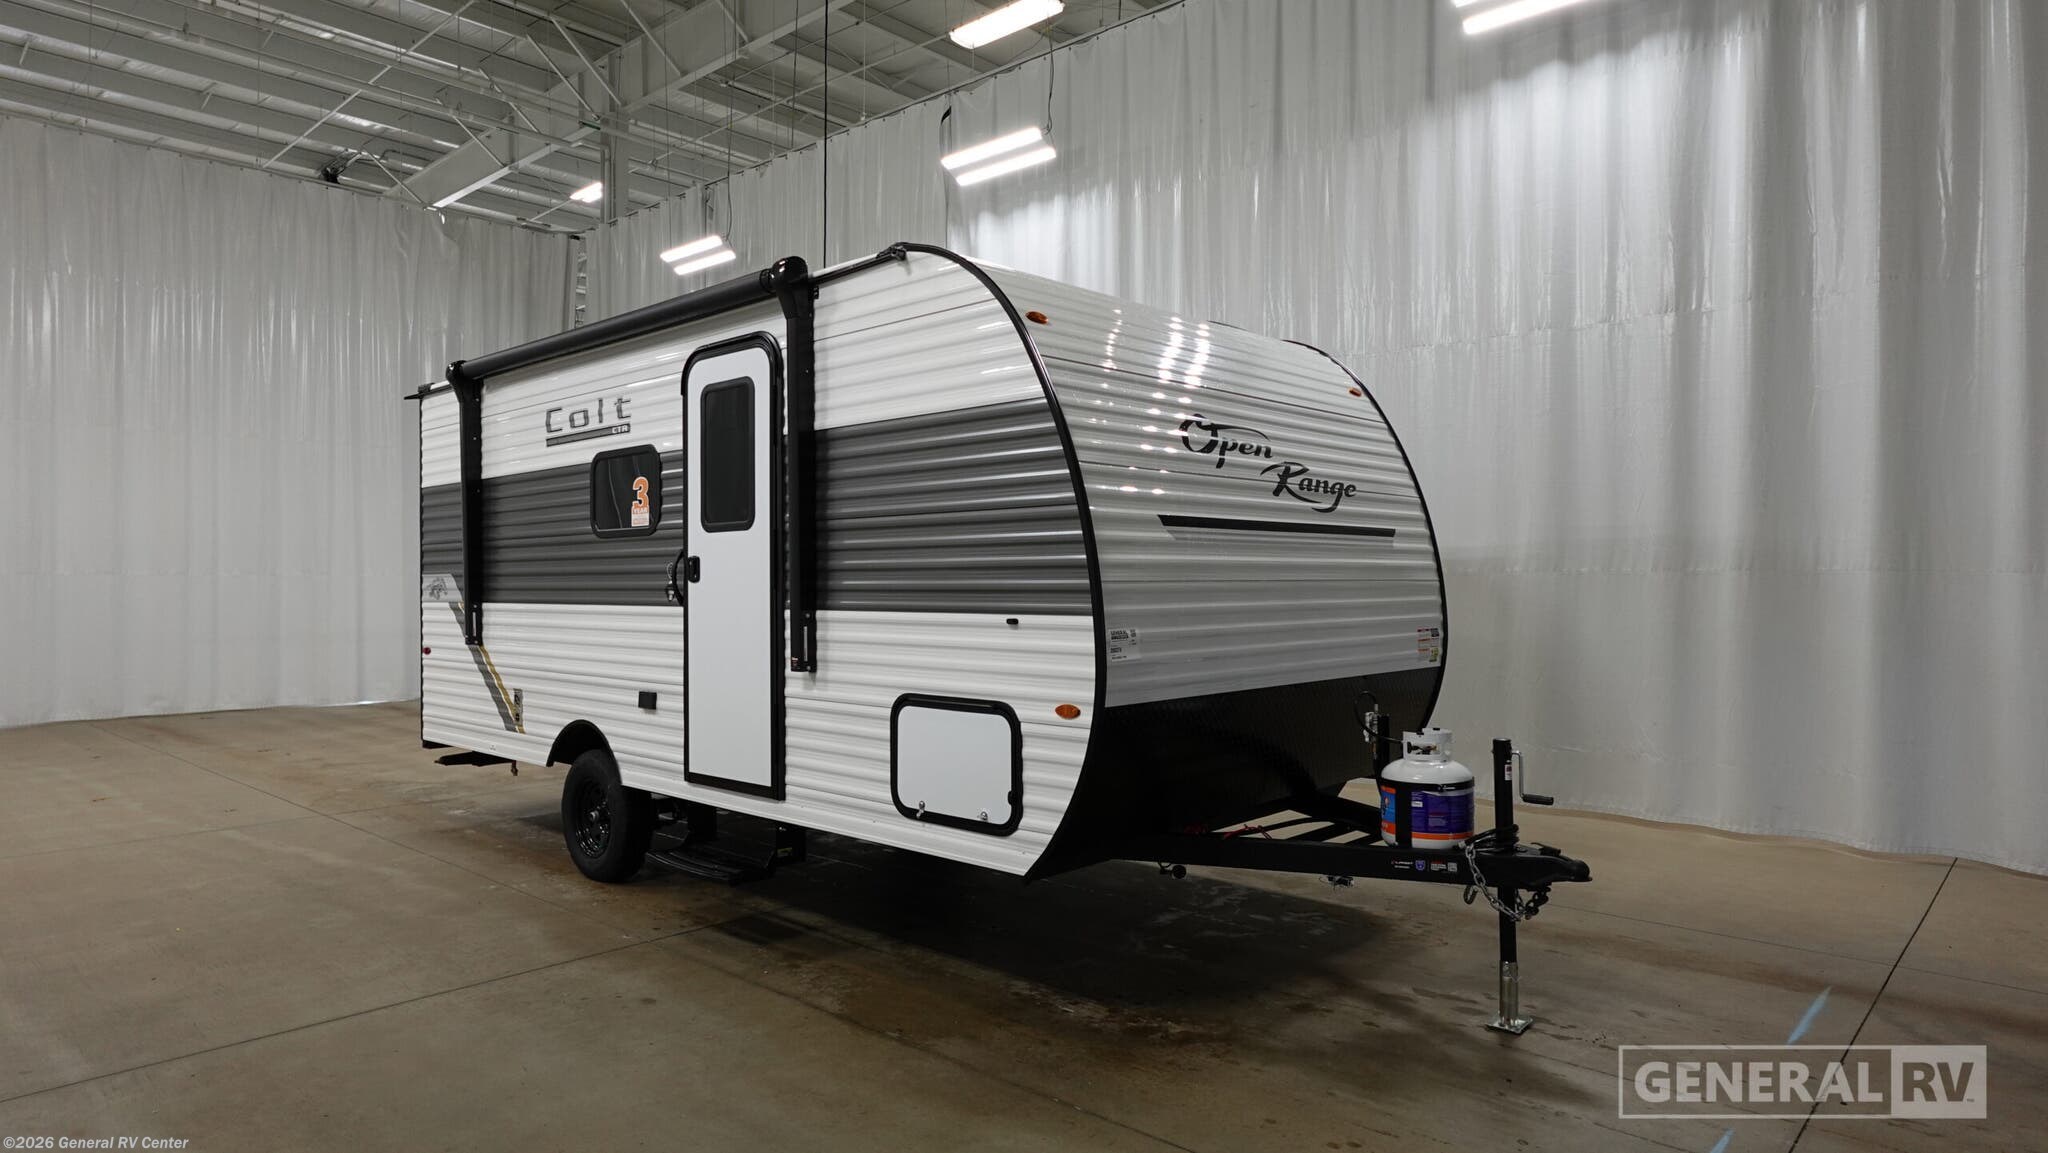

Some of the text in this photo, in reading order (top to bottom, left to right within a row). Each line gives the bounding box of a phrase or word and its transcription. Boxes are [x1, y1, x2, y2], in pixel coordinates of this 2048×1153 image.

[545, 398, 631, 433] Colt
[611, 426, 628, 434] CTR
[1179, 413, 1272, 468] Open
[632, 476, 649, 508] 3
[1260, 461, 1357, 513] Range
